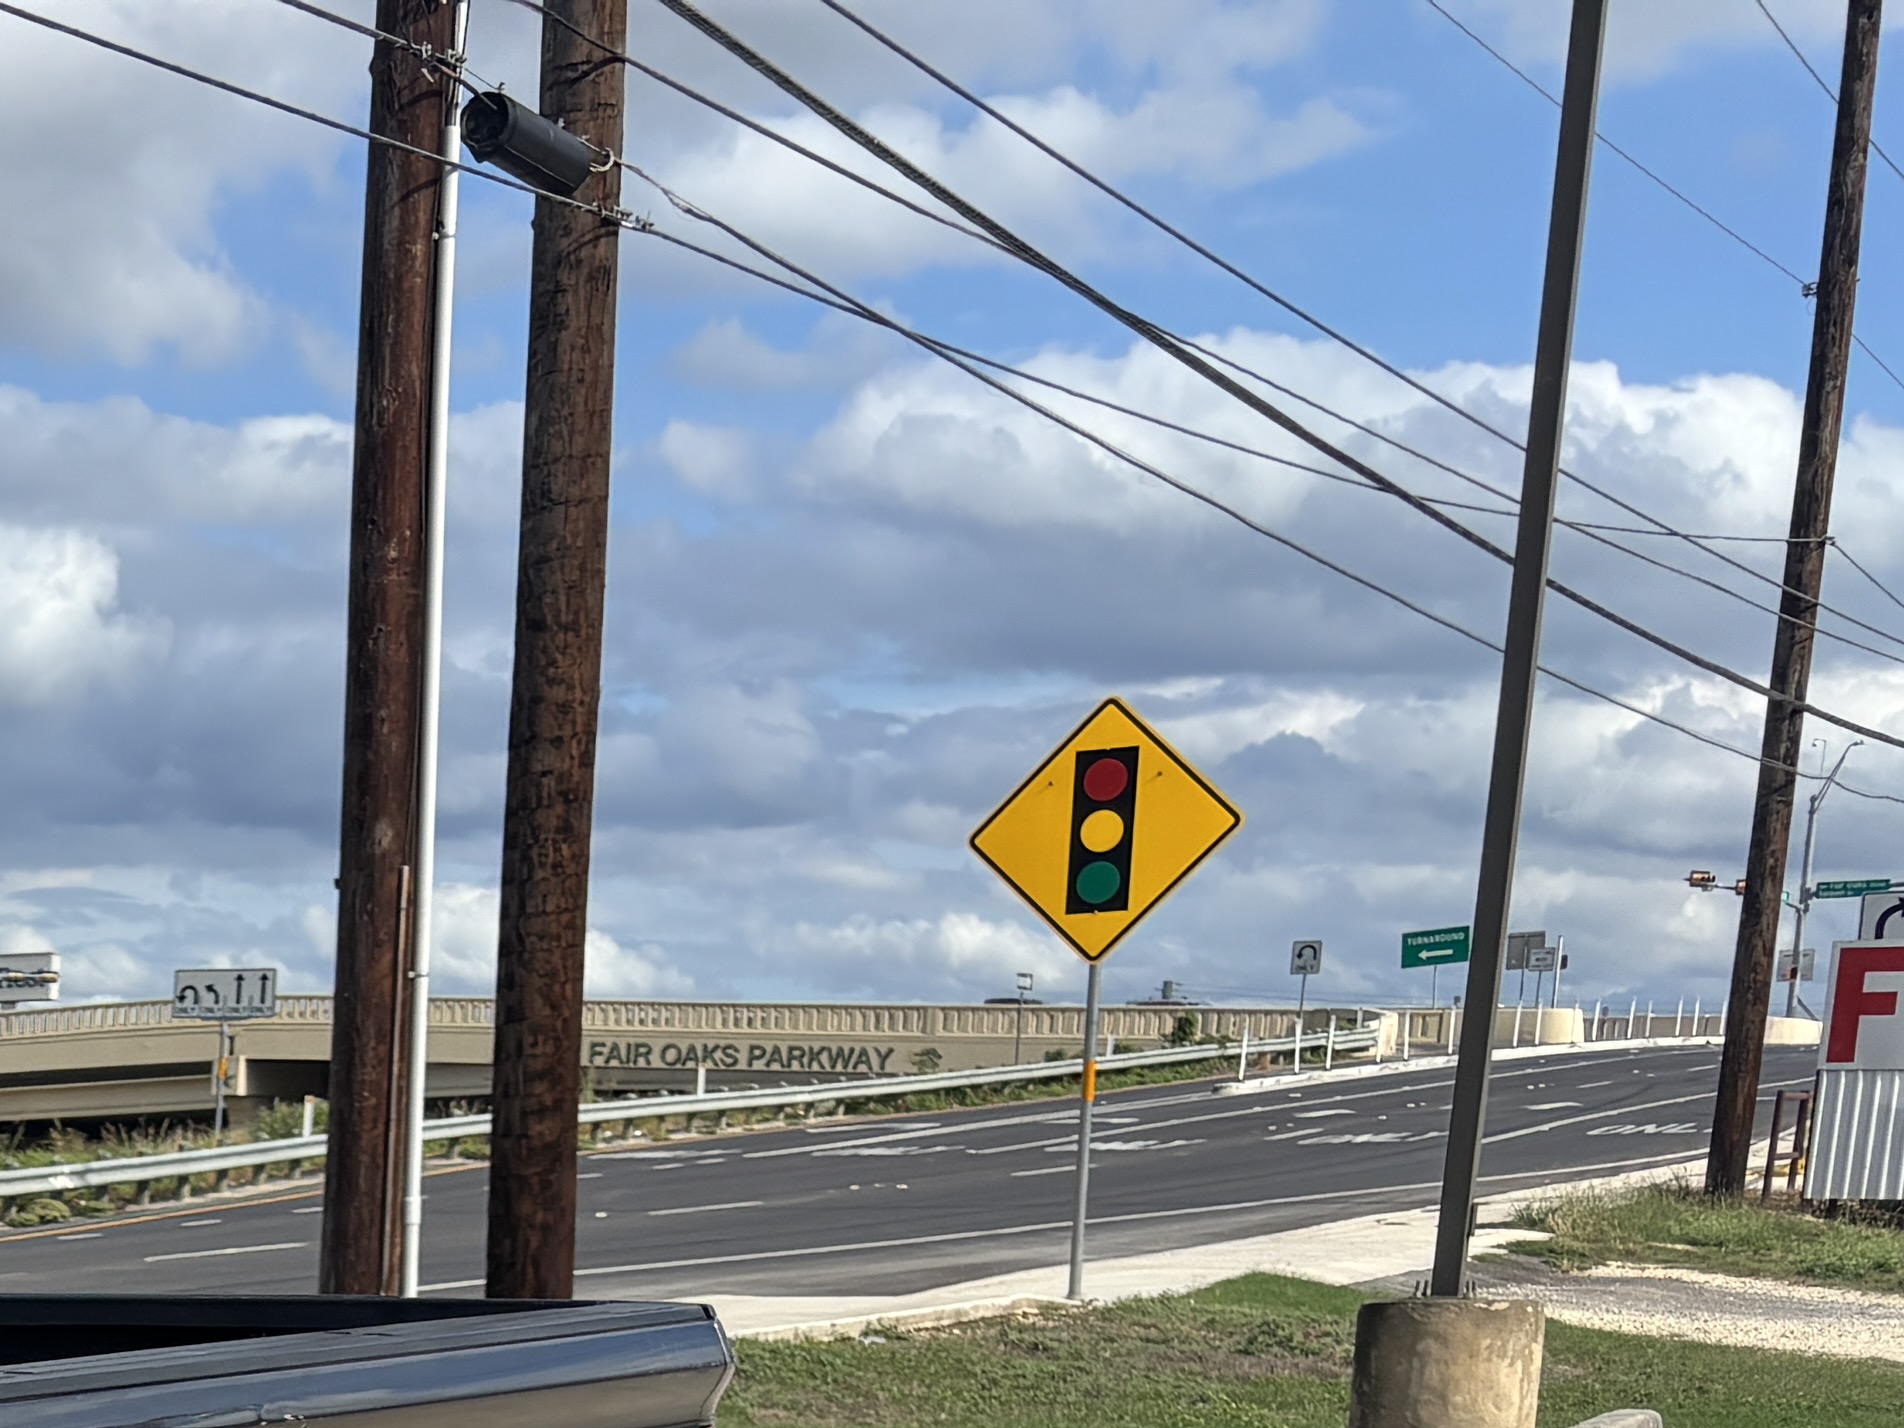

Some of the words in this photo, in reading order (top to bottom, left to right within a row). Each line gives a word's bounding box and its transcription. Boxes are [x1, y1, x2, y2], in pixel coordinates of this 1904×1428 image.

[1407, 931, 1465, 946] TURNAROUND
[587, 1042, 653, 1065] FAIR
[659, 1042, 741, 1068] OAKS
[747, 1045, 894, 1072] PARKWAY
[1586, 1122, 1713, 1135] ONL
